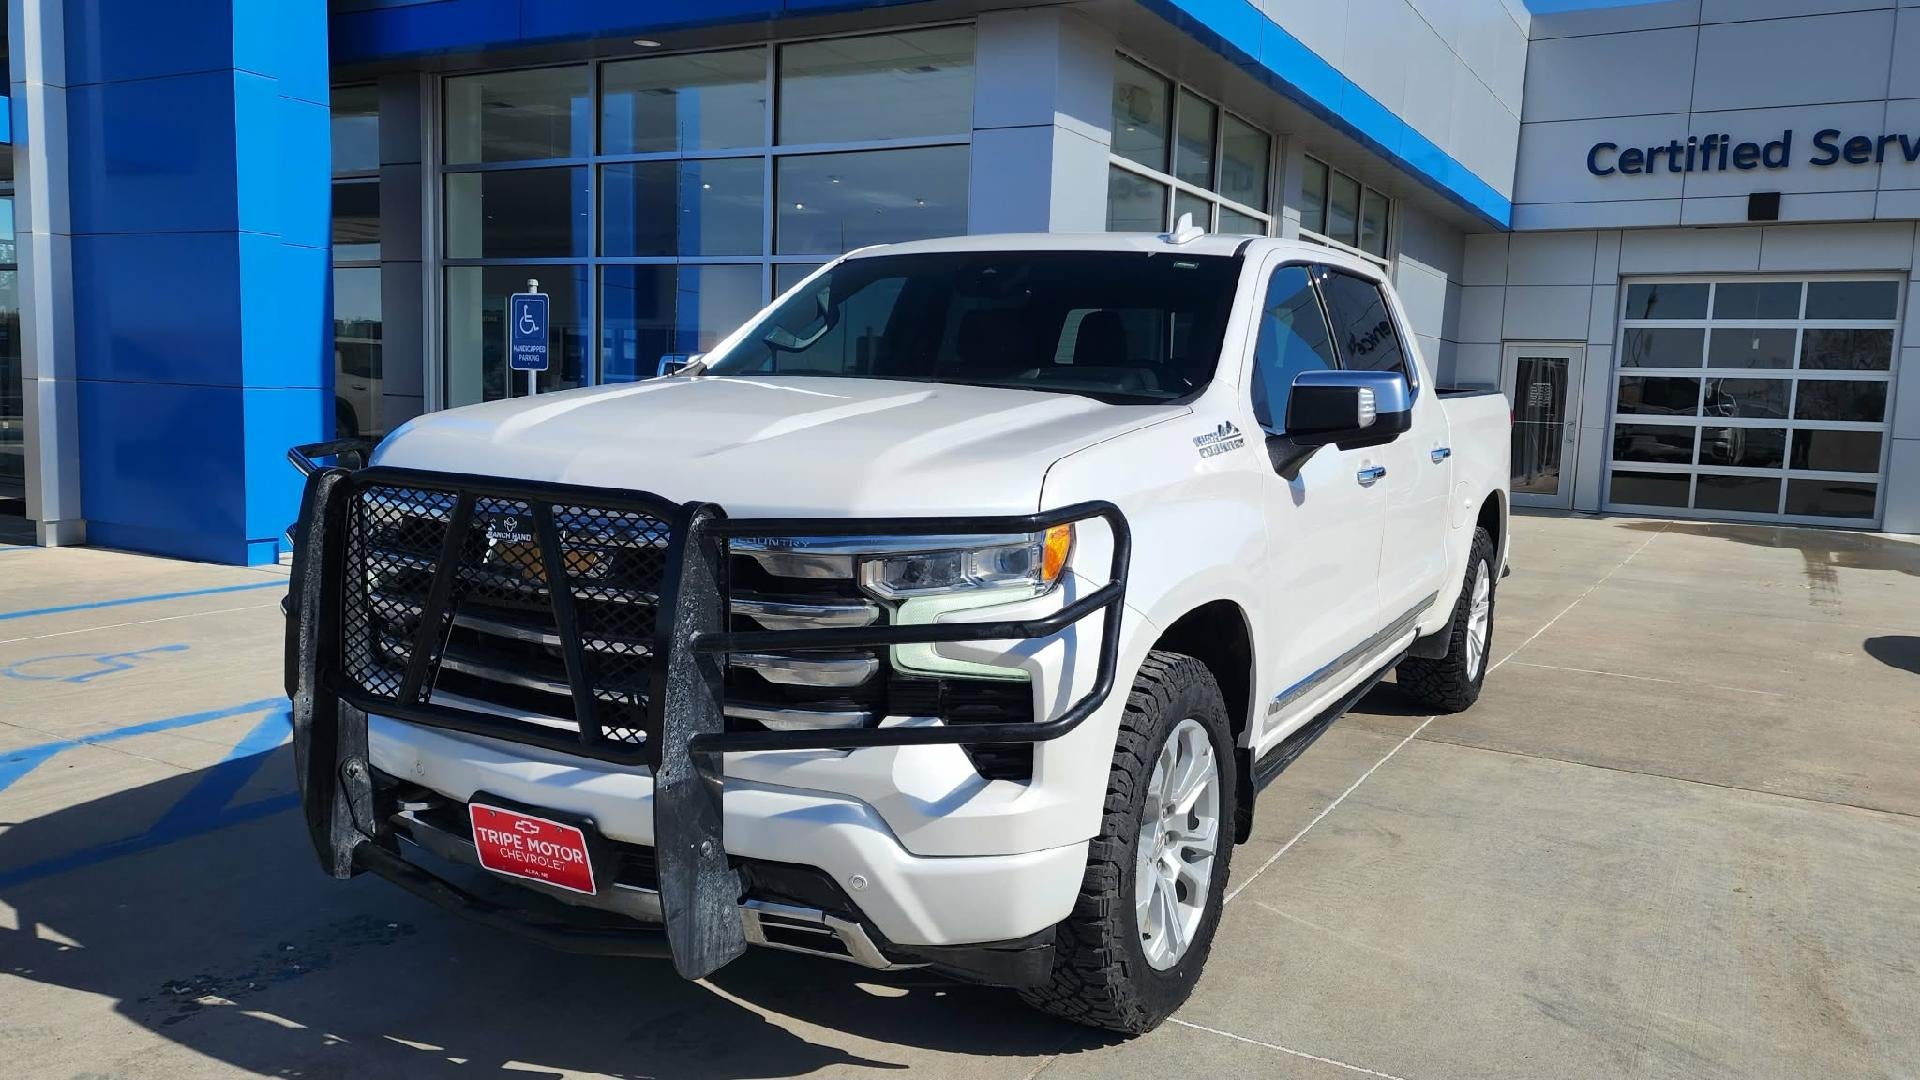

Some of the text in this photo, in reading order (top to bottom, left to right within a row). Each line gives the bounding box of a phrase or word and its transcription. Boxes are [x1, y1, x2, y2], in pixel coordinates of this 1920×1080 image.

[1587, 129, 1792, 176] Certified
[513, 344, 546, 353] HANDICAPPED
[512, 532, 531, 541] HAND
[478, 827, 584, 864] TRIPE MOTOR
[500, 847, 566, 871] CHEVROLET
